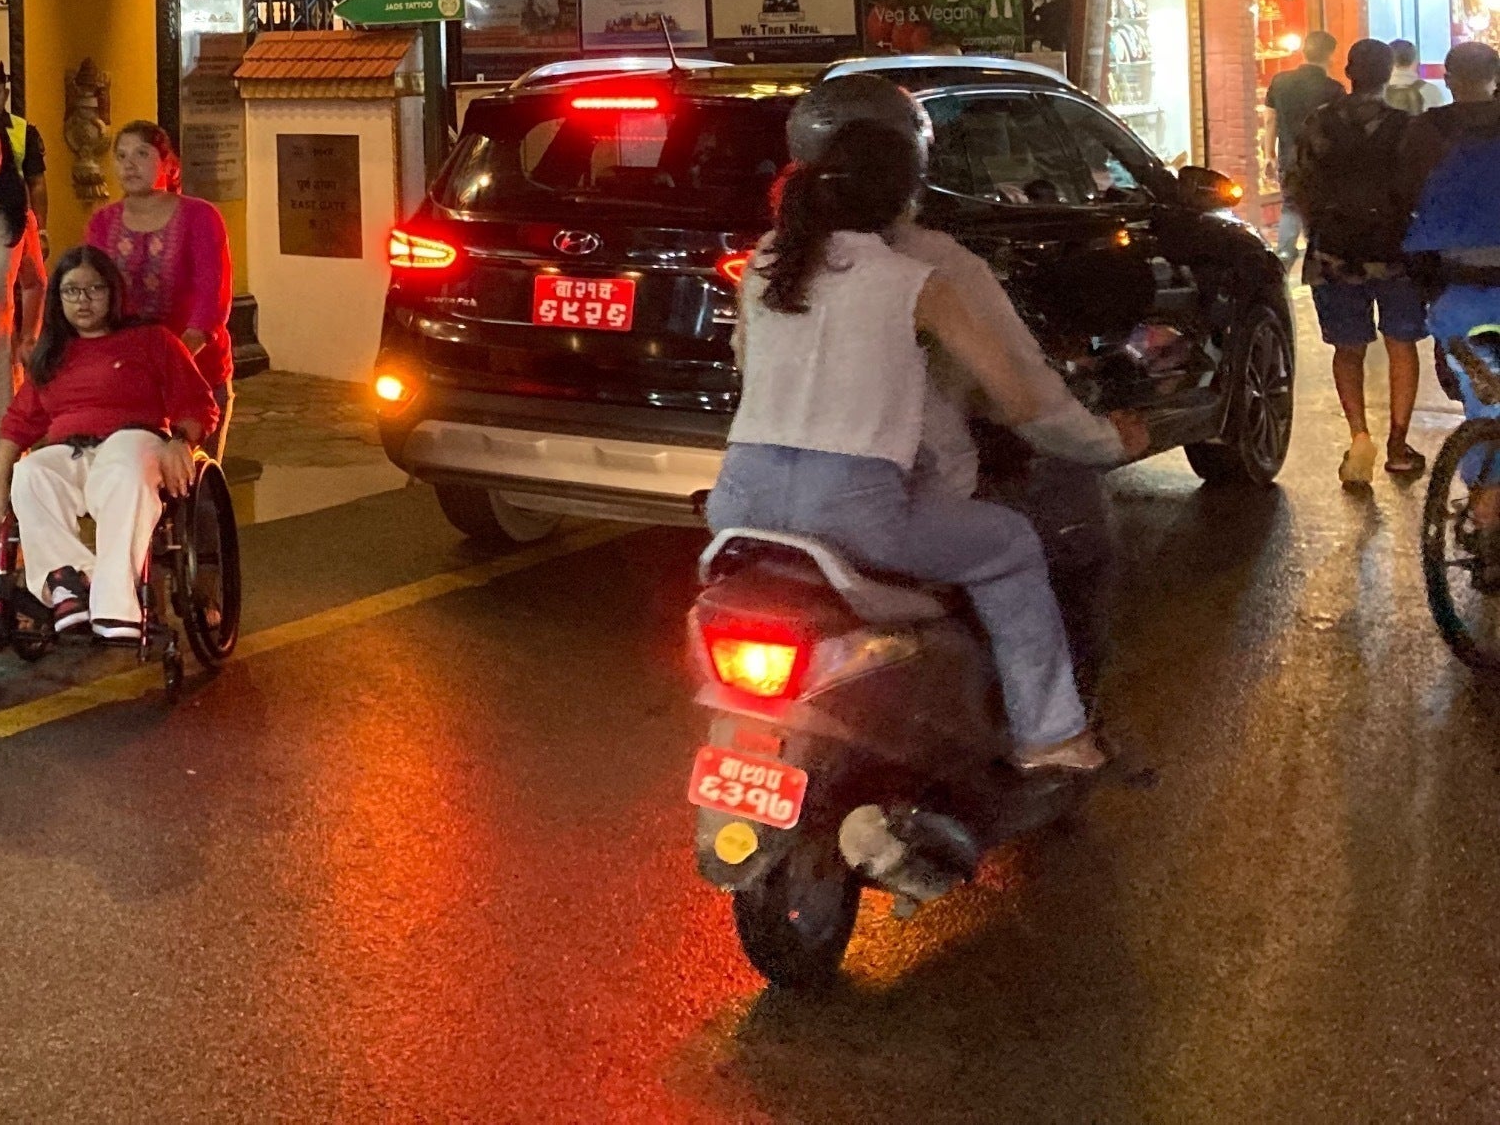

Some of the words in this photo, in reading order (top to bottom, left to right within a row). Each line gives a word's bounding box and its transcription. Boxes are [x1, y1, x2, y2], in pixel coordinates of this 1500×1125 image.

[405, 1, 433, 10] TATTOO
[875, 6, 904, 25] Veg
[908, 5, 920, 22] &
[921, 4, 974, 24] Vegan
